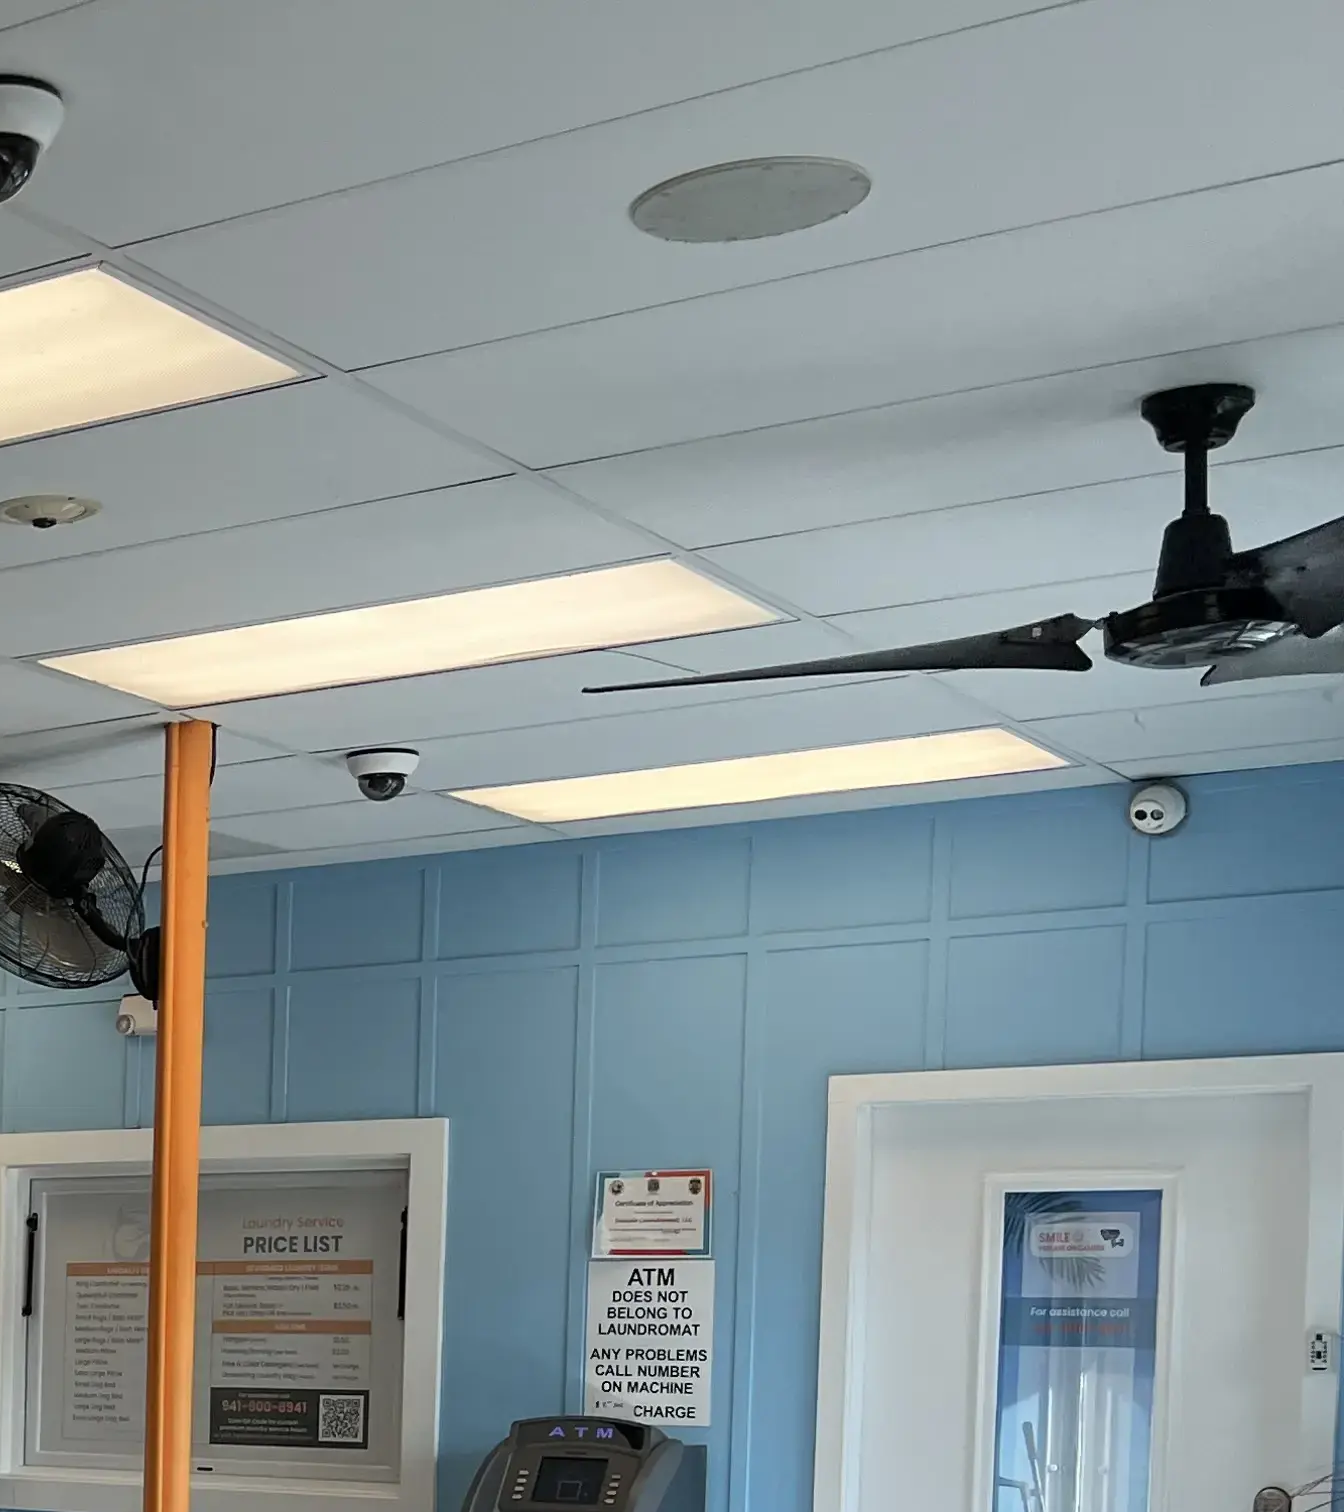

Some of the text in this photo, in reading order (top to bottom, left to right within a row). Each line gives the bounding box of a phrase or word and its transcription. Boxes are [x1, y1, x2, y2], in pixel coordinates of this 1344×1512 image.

[242, 1215, 345, 1231] Laundry Service
[243, 1235, 343, 1253] PRICE LIST
[1039, 1232, 1071, 1243] SMILE
[627, 1268, 675, 1286] ATM
[612, 1290, 688, 1302] DOES NOT
[607, 1306, 693, 1319] BELONG TO
[1030, 1306, 1130, 1317] For assistance call
[598, 1323, 700, 1336] LAUNDROMAT
[590, 1348, 708, 1362] ANY PROBLEMS
[595, 1364, 701, 1378] CALL NUMBER
[601, 1380, 694, 1394] ON MACHINE
[633, 1405, 696, 1419] CHARGE
[548, 1426, 614, 1439] ATM
